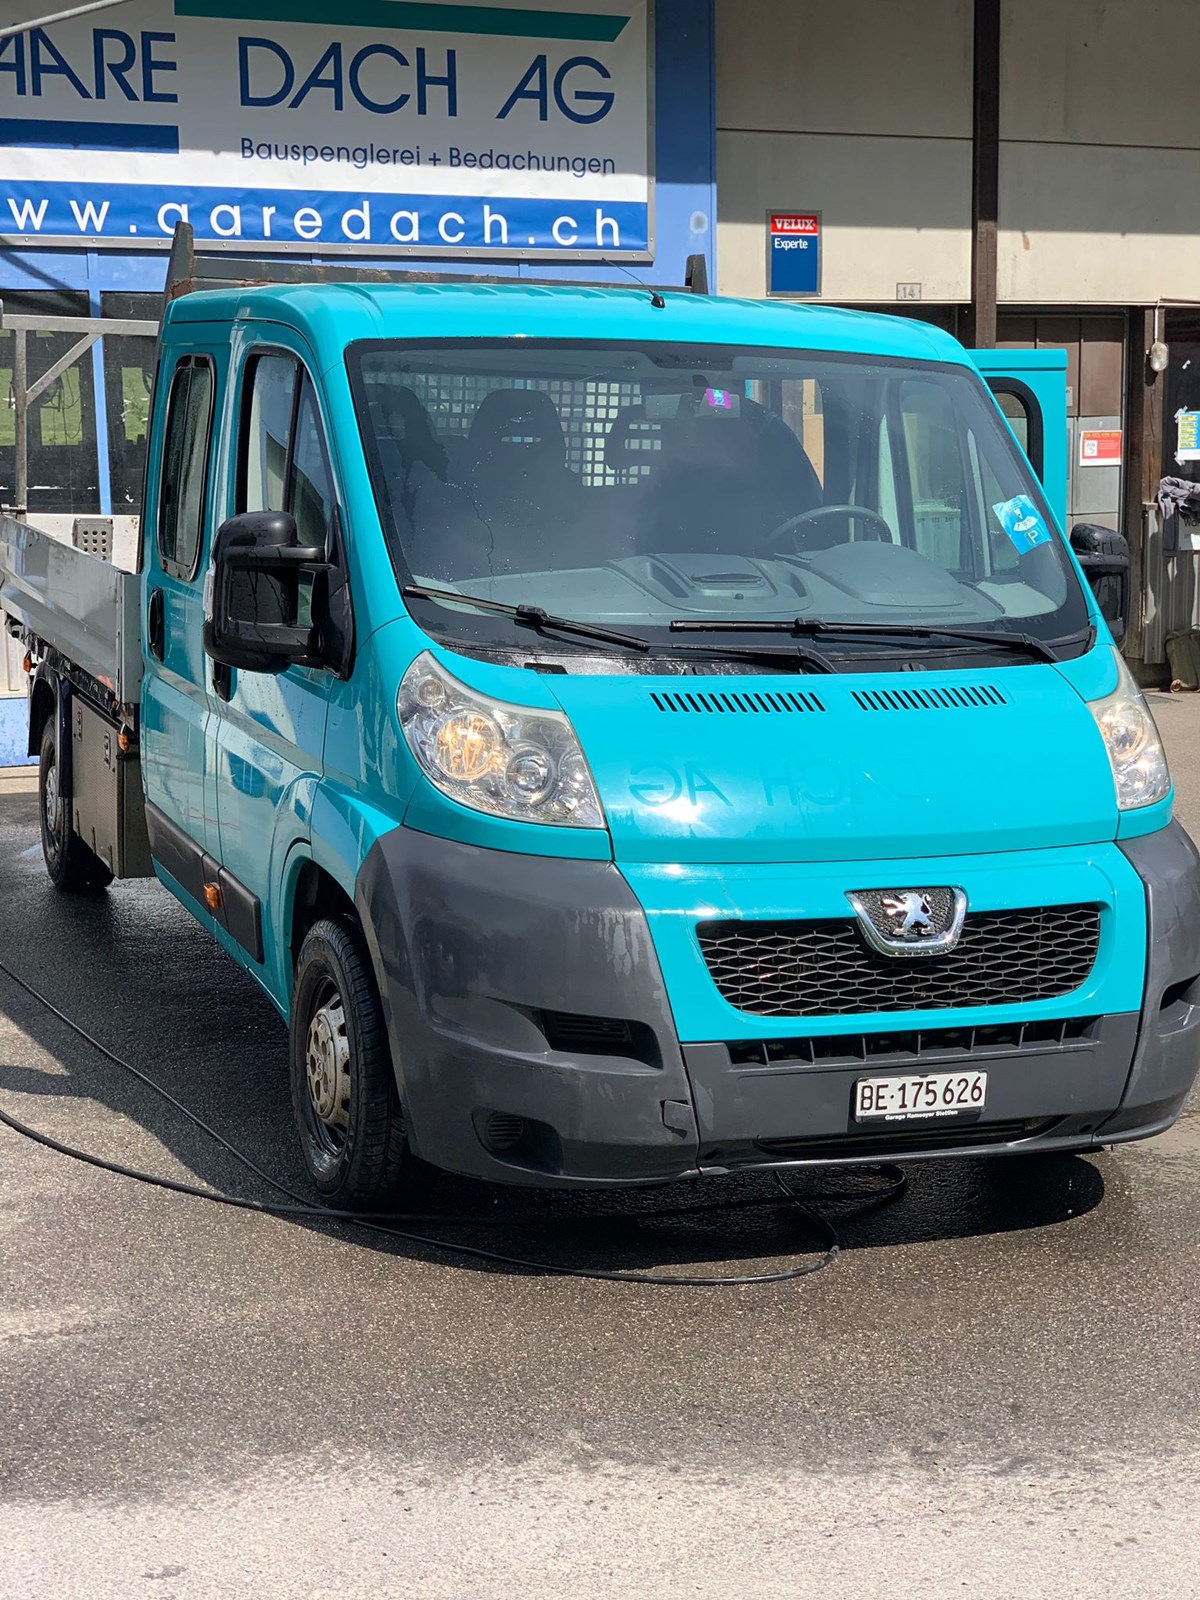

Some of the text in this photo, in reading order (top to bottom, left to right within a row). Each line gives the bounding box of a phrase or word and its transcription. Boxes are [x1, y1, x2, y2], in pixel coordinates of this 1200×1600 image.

[237, 36, 458, 117] DACH
[496, 54, 616, 125] AG
[240, 137, 616, 178] Bauspenglerei + Bedachungen
[774, 218, 815, 231] VELUX
[774, 237, 808, 250] Experte
[902, 286, 915, 299] 14
